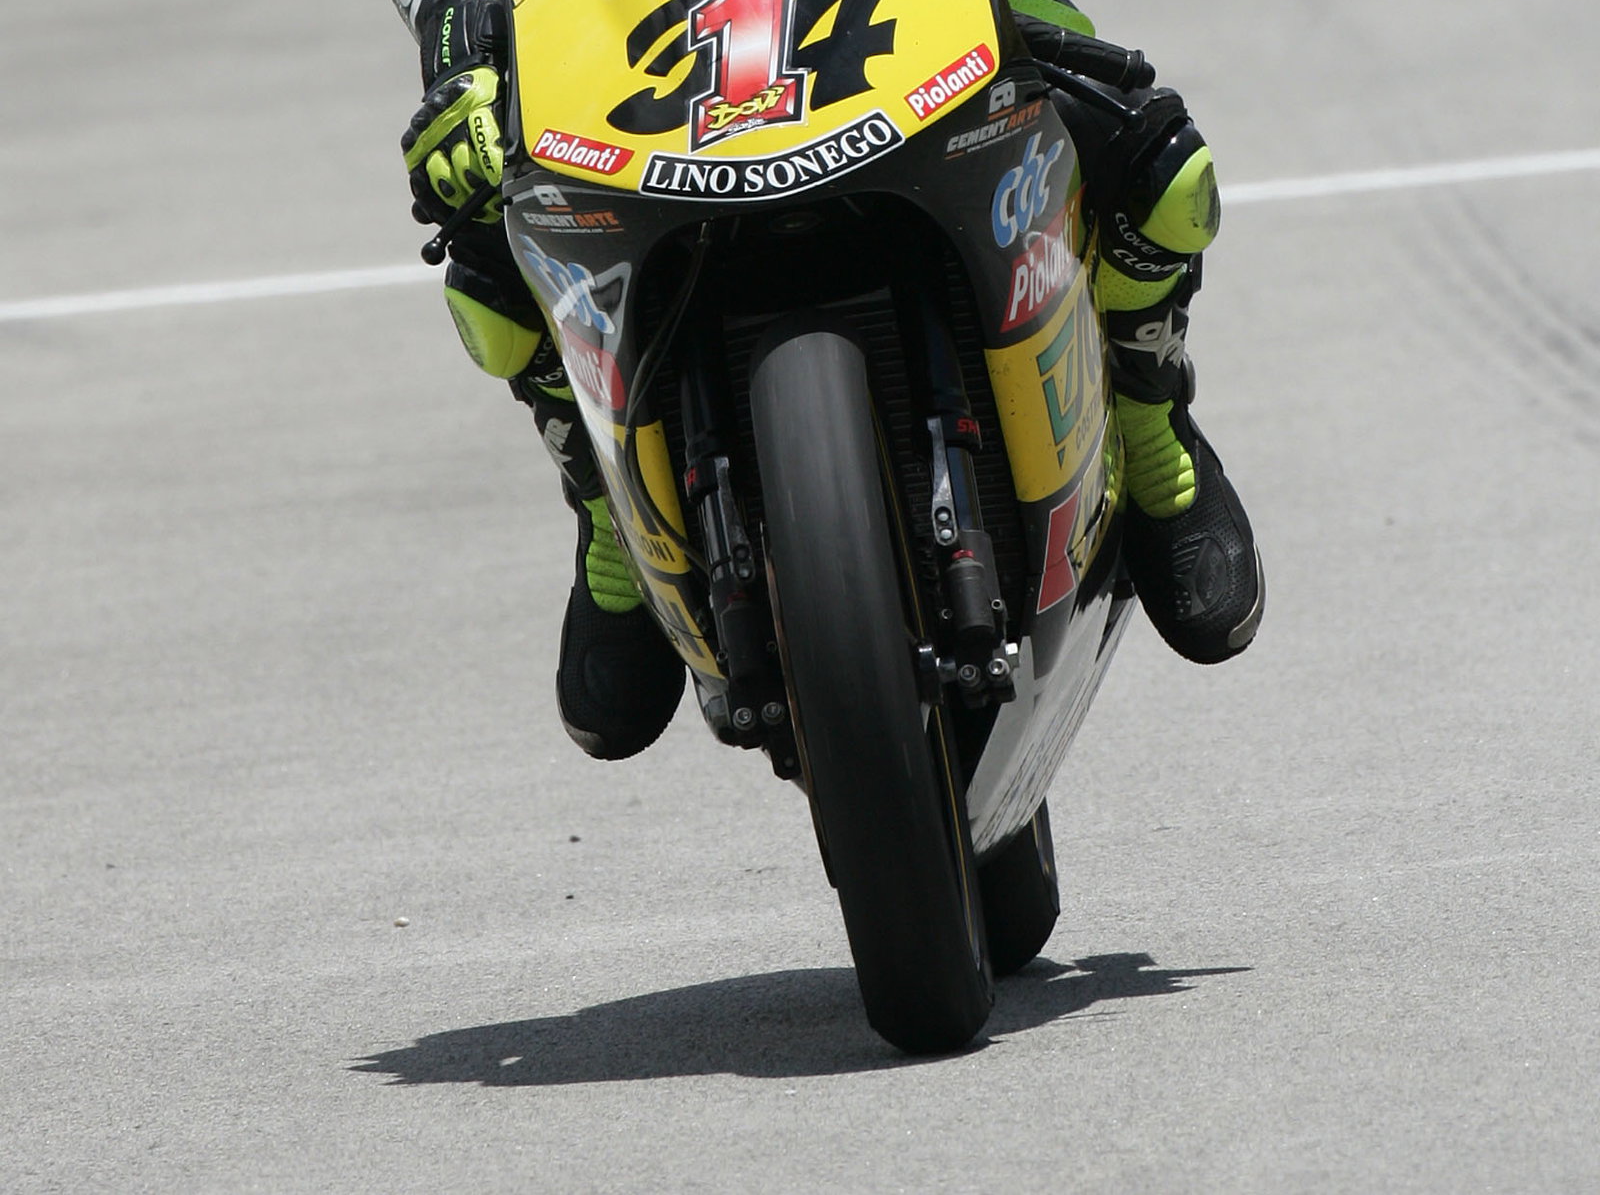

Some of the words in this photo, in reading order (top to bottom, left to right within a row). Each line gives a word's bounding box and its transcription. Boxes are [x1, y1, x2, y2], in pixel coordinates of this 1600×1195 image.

[907, 51, 988, 117] Piolanti
[534, 131, 621, 172] Piolanti
[647, 159, 736, 194] LINO
[744, 119, 892, 193] SONEGO
